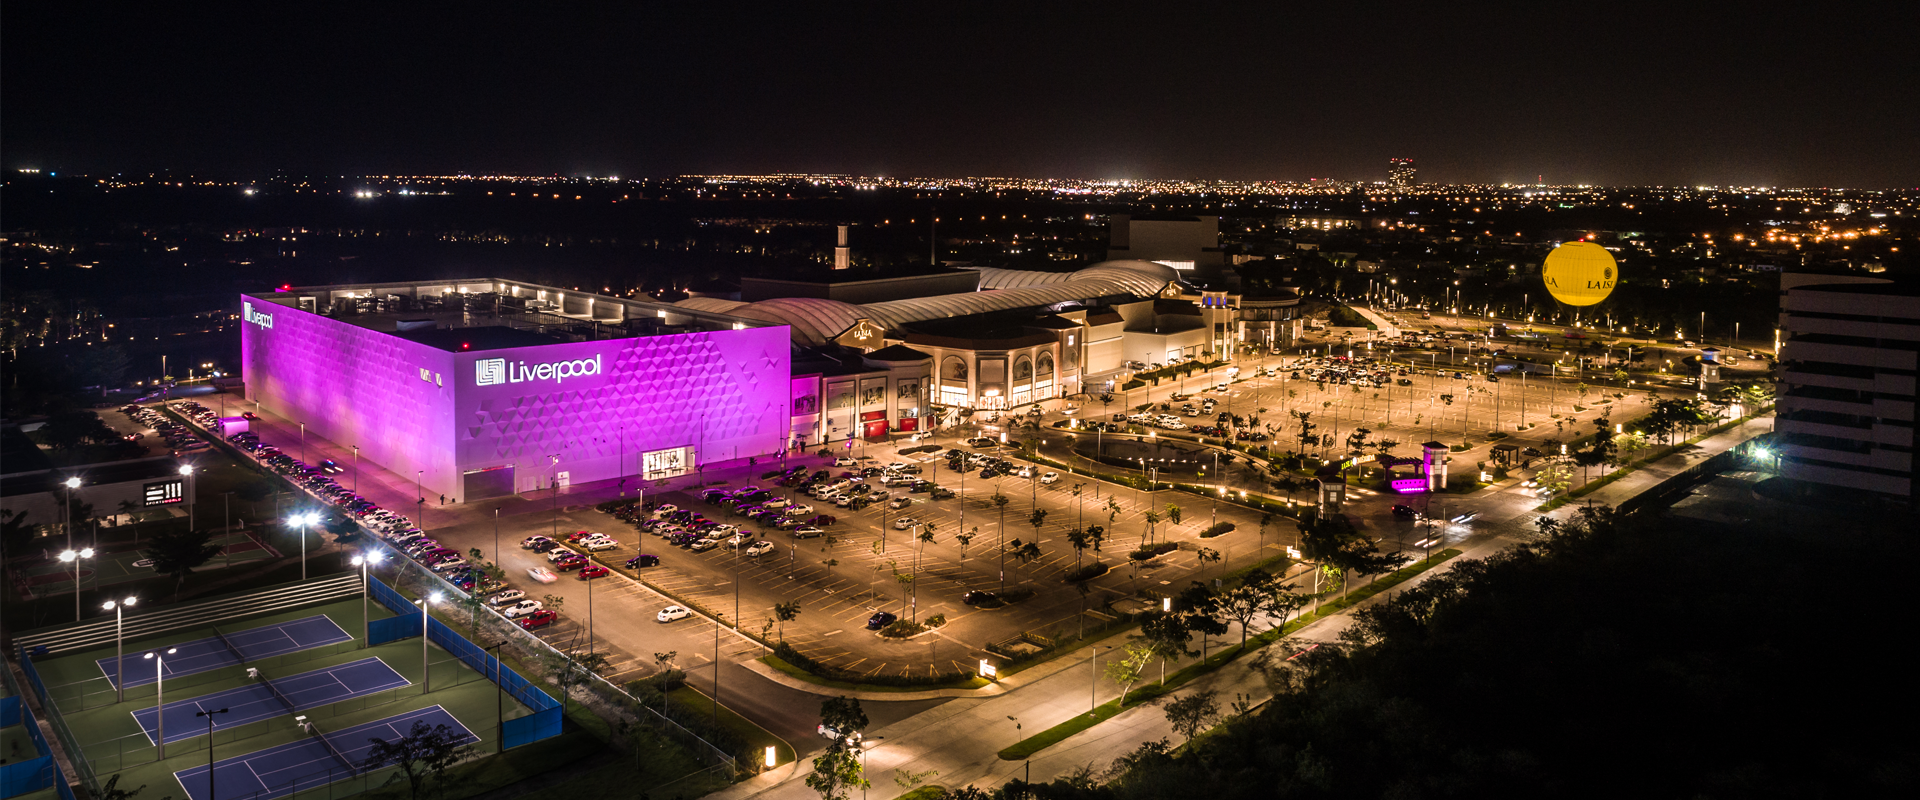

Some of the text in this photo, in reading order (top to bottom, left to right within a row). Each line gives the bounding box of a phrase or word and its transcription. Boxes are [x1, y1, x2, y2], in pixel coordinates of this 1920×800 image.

[1587, 280, 1601, 290] LA
[250, 306, 273, 331] Liverpool
[509, 353, 601, 384] Liverpool
